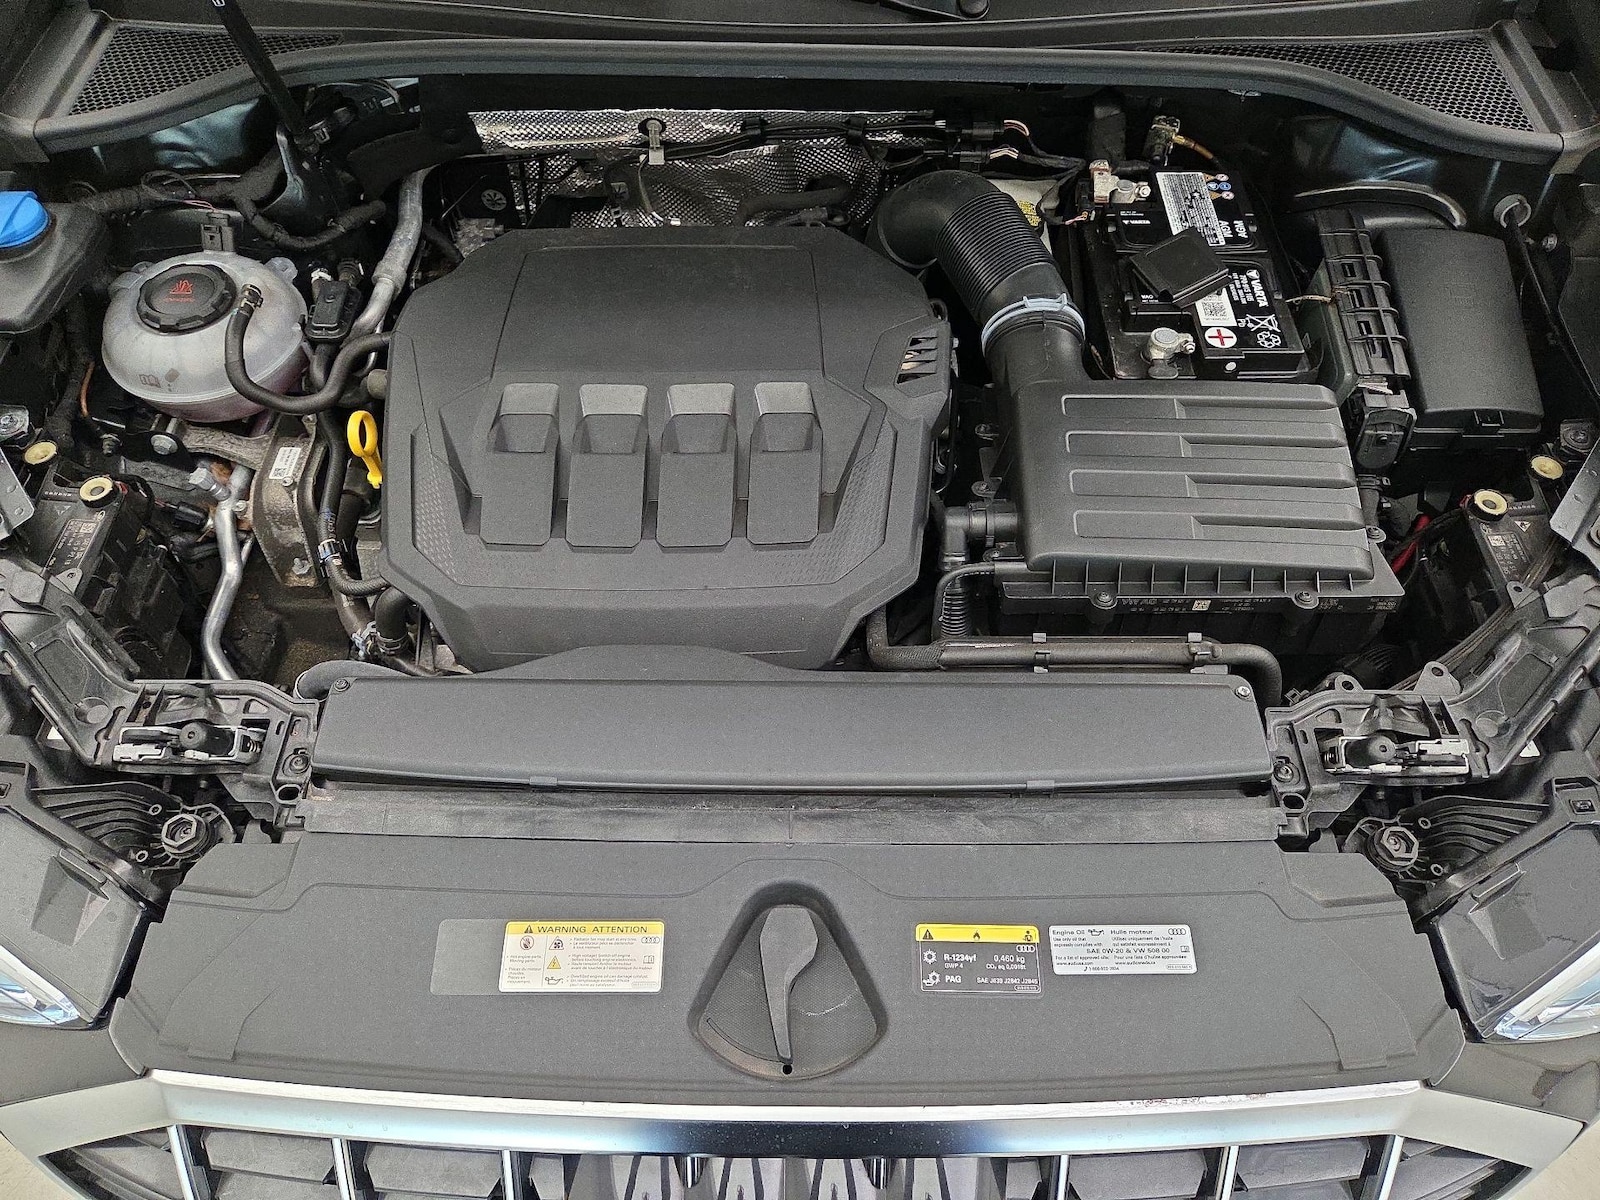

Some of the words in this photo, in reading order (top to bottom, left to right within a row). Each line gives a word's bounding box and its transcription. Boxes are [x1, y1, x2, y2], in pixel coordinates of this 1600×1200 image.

[1218, 220, 1234, 238] AGM
[1234, 220, 1248, 238] AGM
[1250, 279, 1269, 308] VARTA
[943, 954, 977, 963] R-1234yf
[993, 955, 1014, 963] 0,460
[1016, 955, 1025, 963] kg
